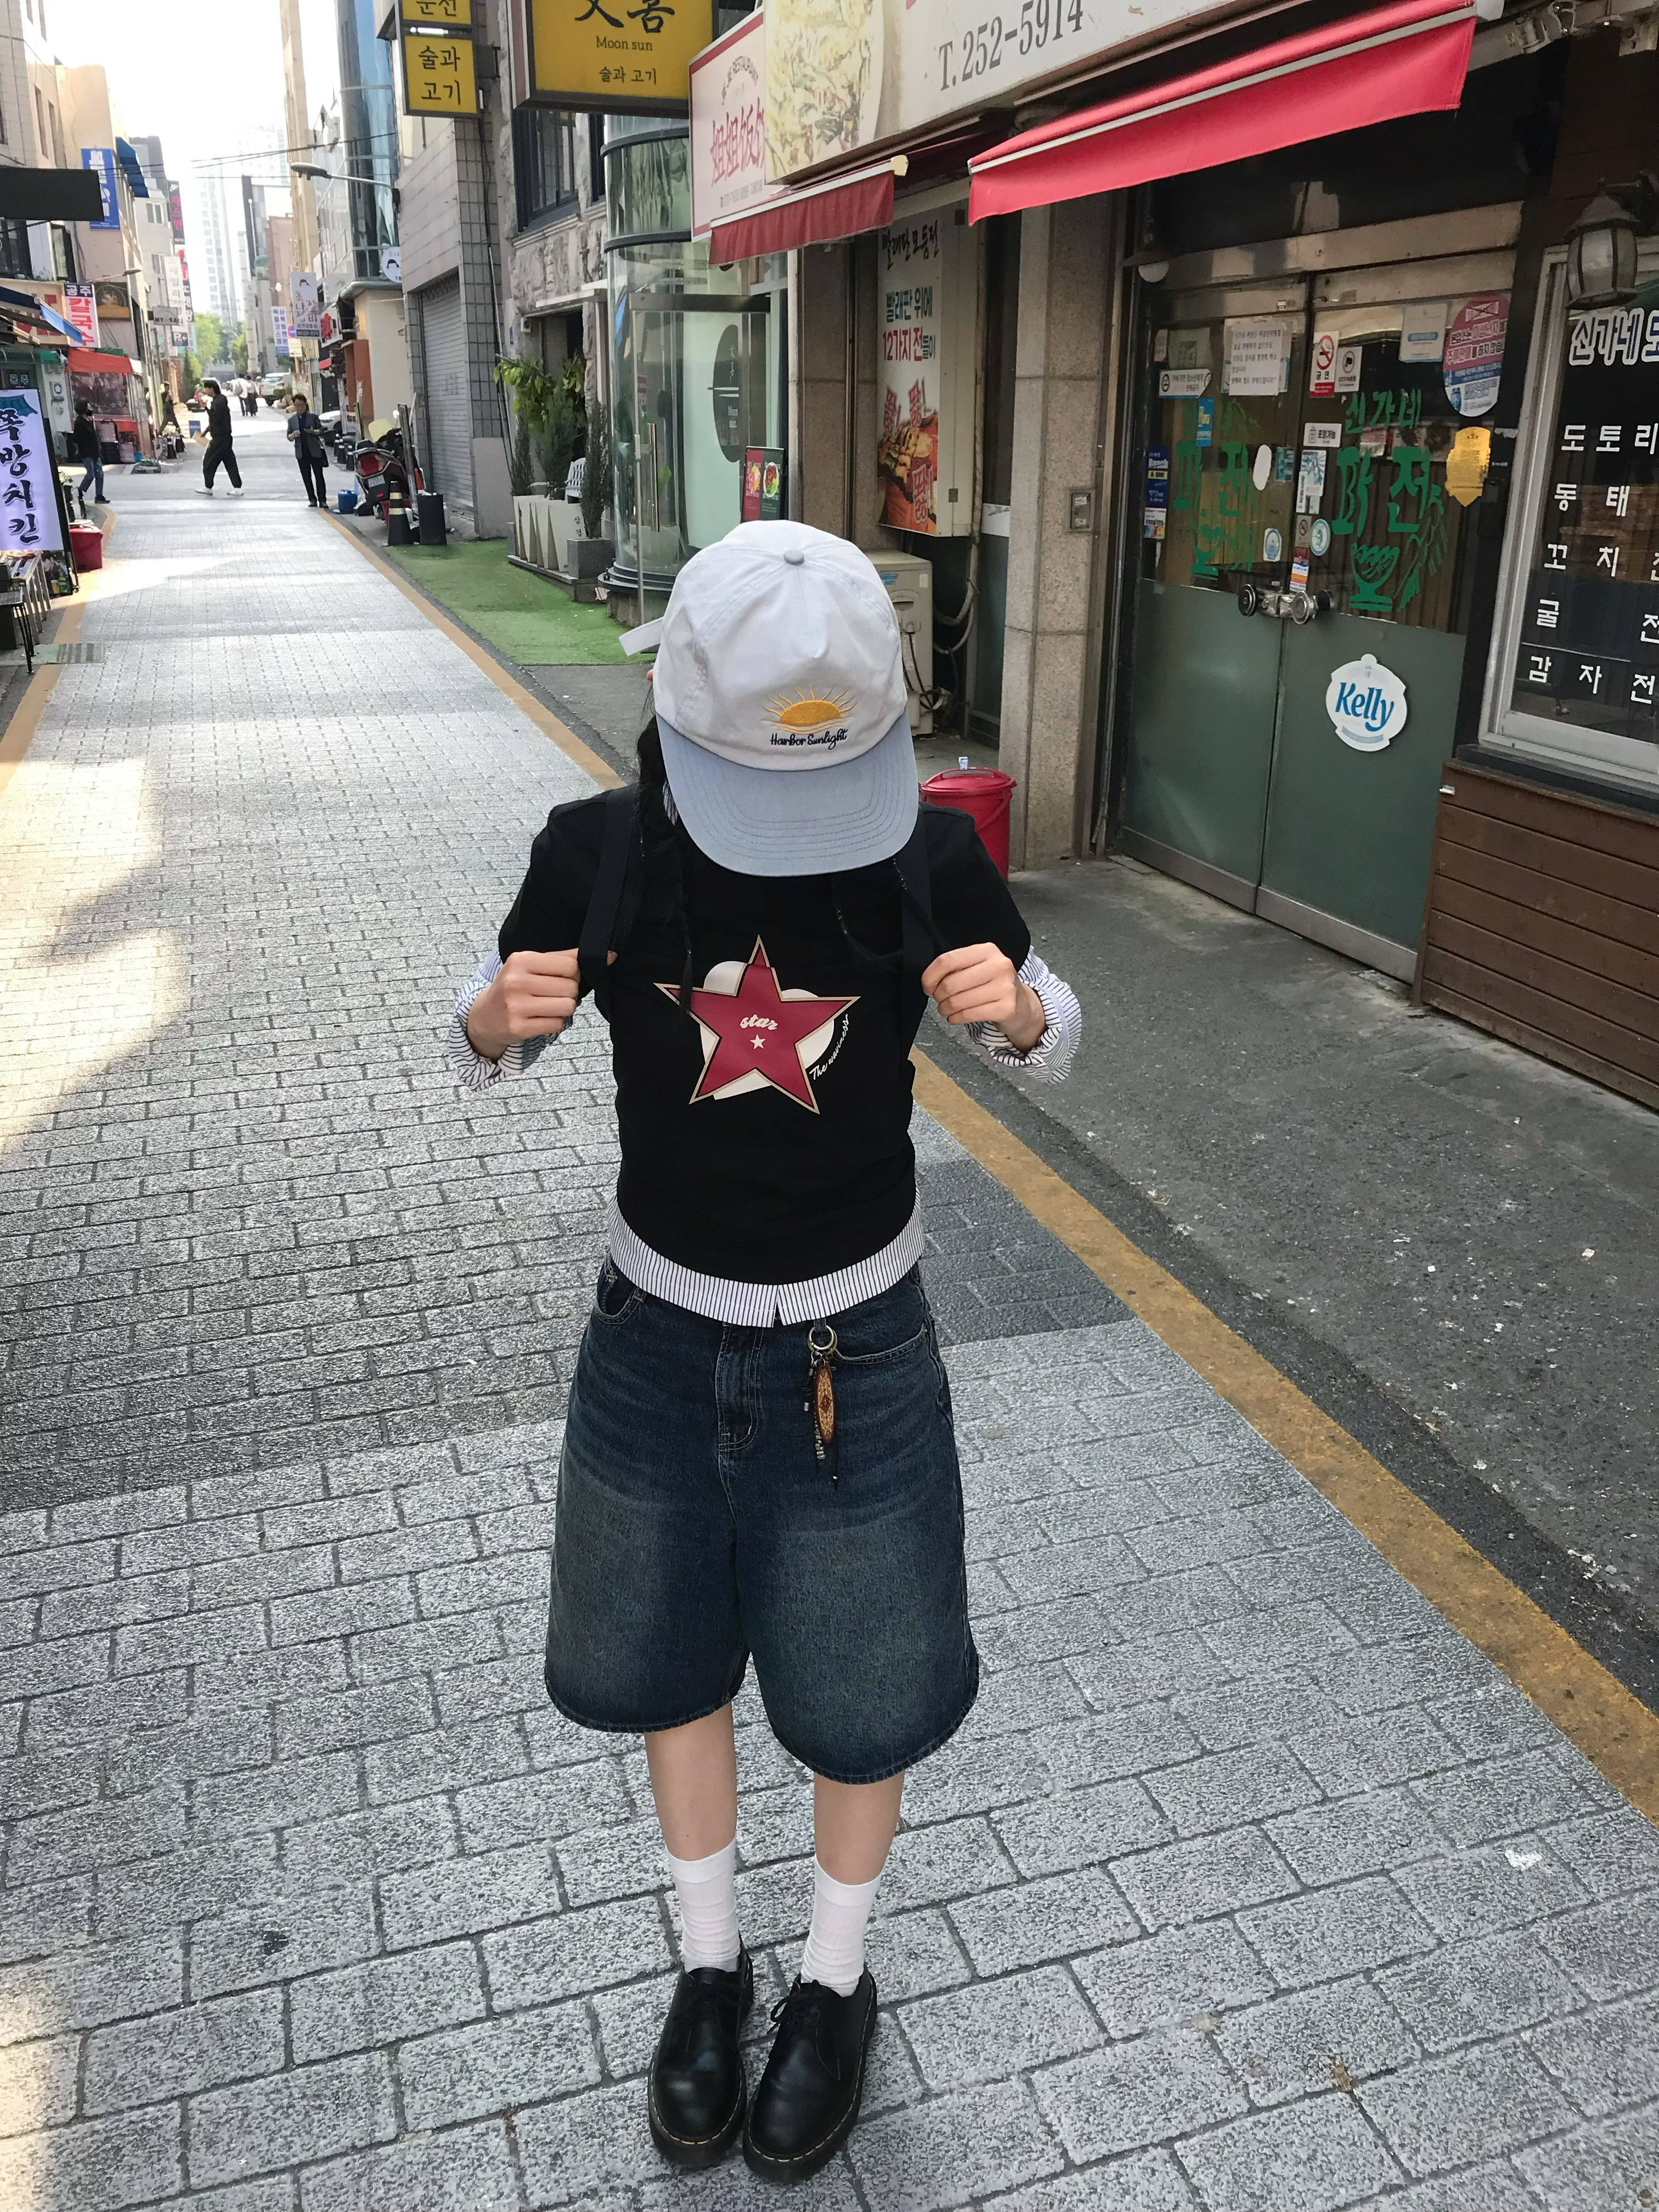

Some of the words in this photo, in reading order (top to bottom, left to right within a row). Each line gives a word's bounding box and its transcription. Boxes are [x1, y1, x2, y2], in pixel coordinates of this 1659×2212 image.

[596, 35, 629, 49] Moon
[631, 41, 653, 51] sun
[939, 0, 1084, 91] T.252-5914
[418, 46, 460, 72] 술과
[599, 66, 626, 83] 술과
[631, 68, 657, 85] 고기
[421, 80, 460, 105] 고기
[66, 285, 91, 296] 공주
[915, 286, 932, 319] 위에
[69, 298, 94, 346] 칼국수
[1568, 307, 1645, 366] 신가네
[883, 328, 911, 362] 12가지
[913, 326, 936, 362] 전들이
[1345, 388, 1421, 433] 신가네
[1561, 423, 1659, 455] 도토리
[1335, 682, 1395, 732] Kelly
[808, 728, 848, 750] Sunlight
[740, 1014, 778, 1030] star
[809, 1062, 827, 1080] The
